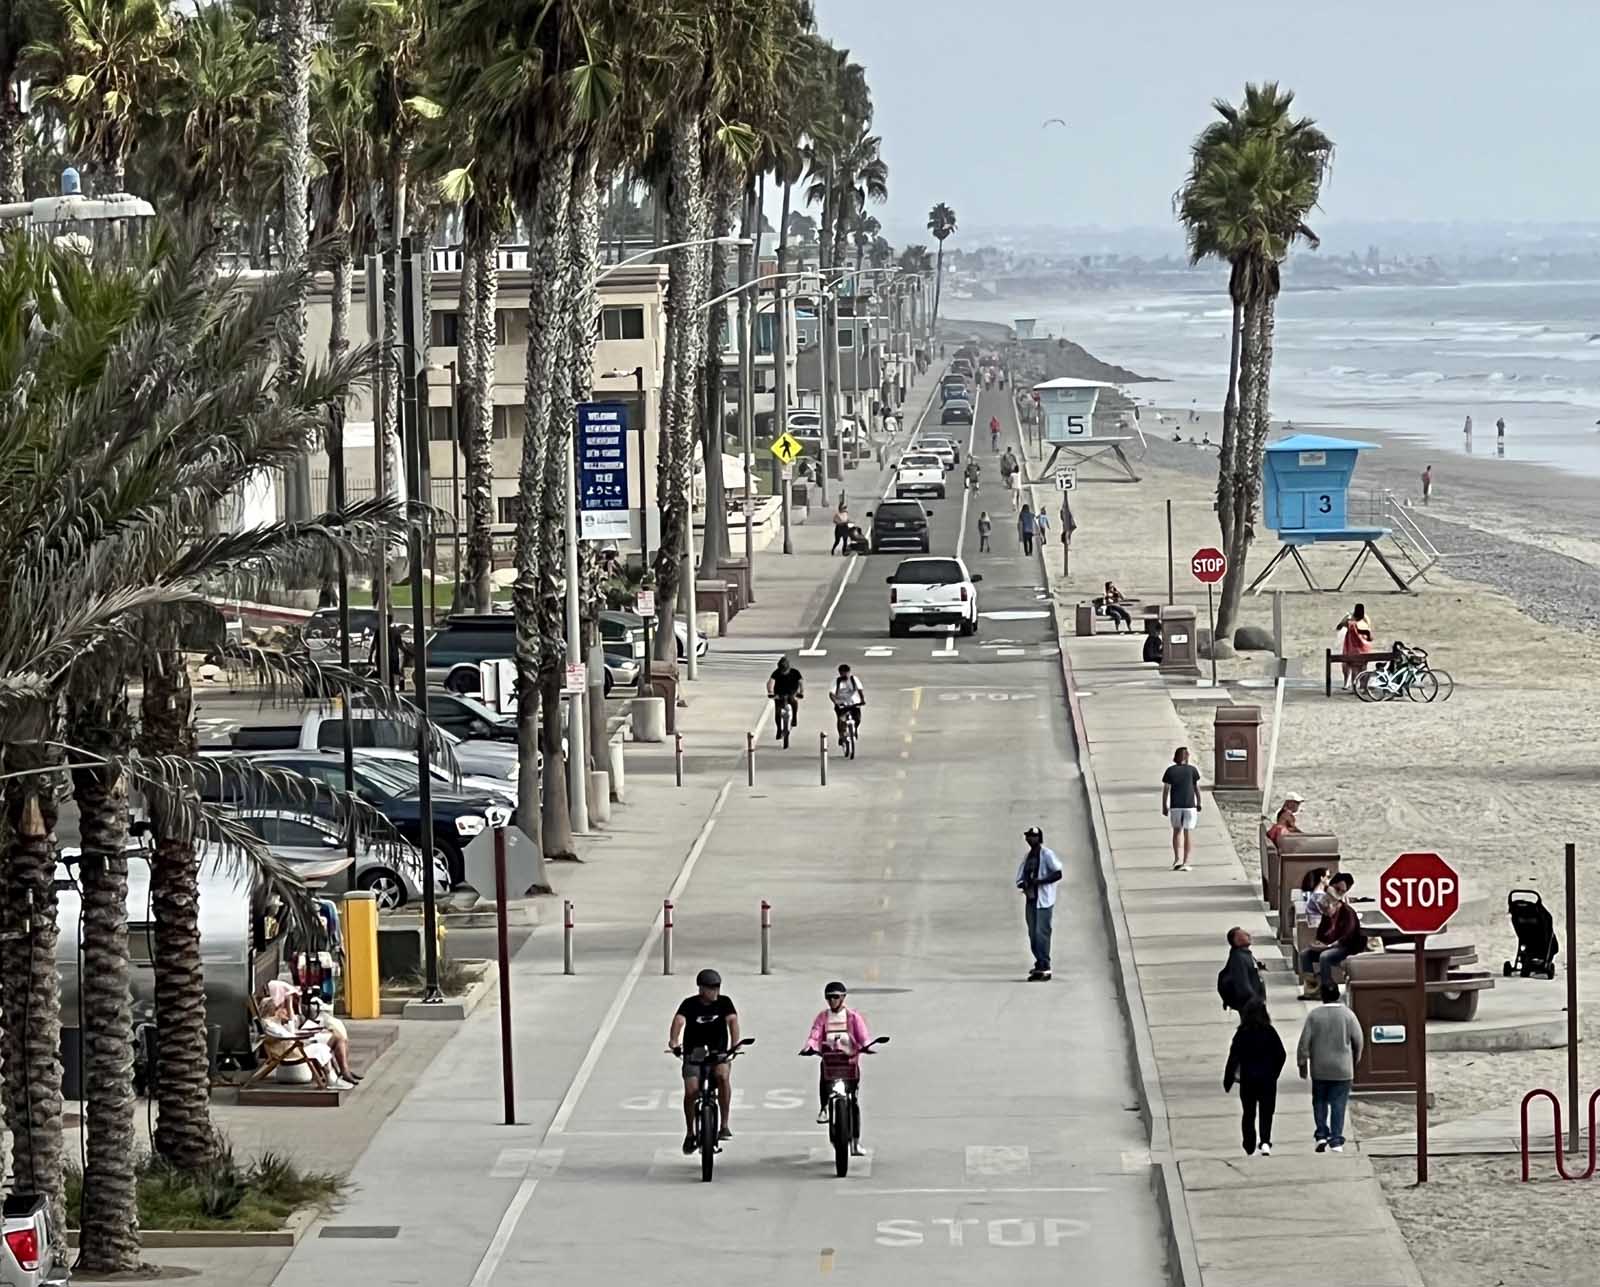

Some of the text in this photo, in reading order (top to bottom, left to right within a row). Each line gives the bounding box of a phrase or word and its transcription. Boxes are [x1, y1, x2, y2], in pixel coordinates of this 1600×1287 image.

[1068, 416, 1083, 434] 5
[1060, 479, 1072, 489] 15
[1319, 495, 1331, 513] 3
[1193, 558, 1224, 573] STOP
[1384, 877, 1455, 908] STOP
[874, 1217, 1091, 1247] STOP
